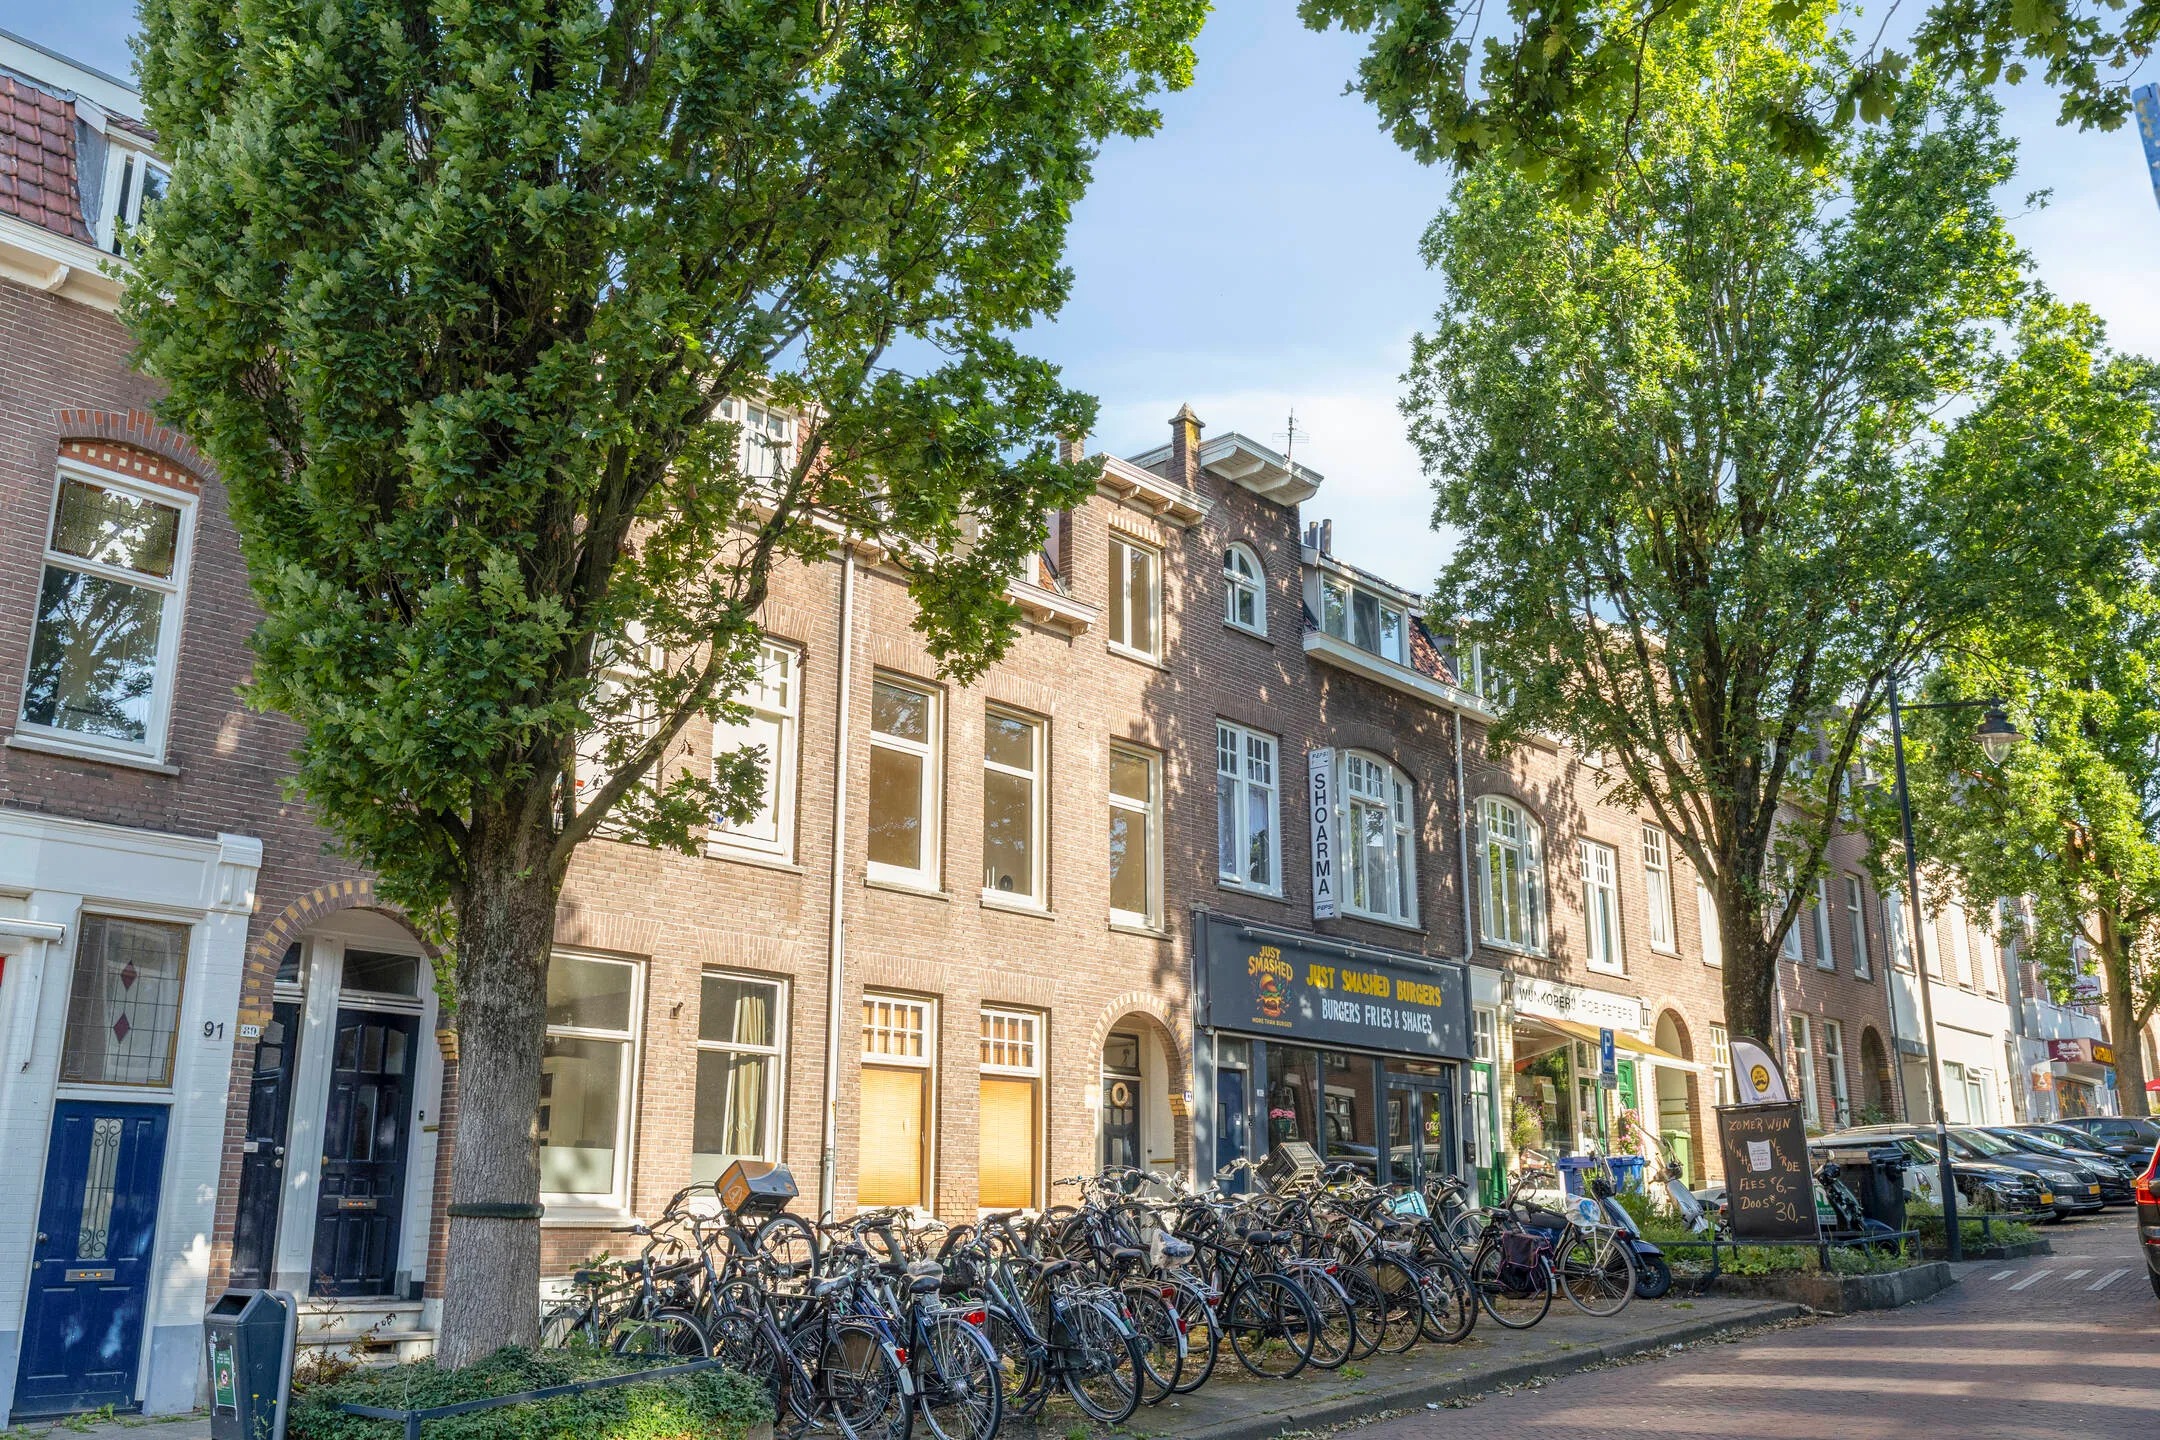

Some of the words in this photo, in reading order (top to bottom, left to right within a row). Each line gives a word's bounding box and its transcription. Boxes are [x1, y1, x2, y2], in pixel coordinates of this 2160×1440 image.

[1314, 773, 1330, 896] SHOARMA
[1259, 945, 1281, 959] JUST
[1248, 955, 1294, 983] SMASHED
[1306, 963, 1336, 990] JUST
[1341, 969, 1391, 998] SMASHED
[1396, 979, 1442, 1008] BURGERS
[203, 1020, 224, 1040] 91
[1321, 998, 1361, 1024] BURGERS
[1364, 1004, 1392, 1029] FRIES
[1394, 1009, 1400, 1029] &
[1401, 1010, 1433, 1035] SHAKES
[1604, 1032, 1611, 1054] P
[1728, 1118, 1763, 1132] ZOMER
[1765, 1118, 1791, 1132] WIJN
[1728, 1139, 1753, 1173] VINHO
[1769, 1137, 1801, 1172] VERDE
